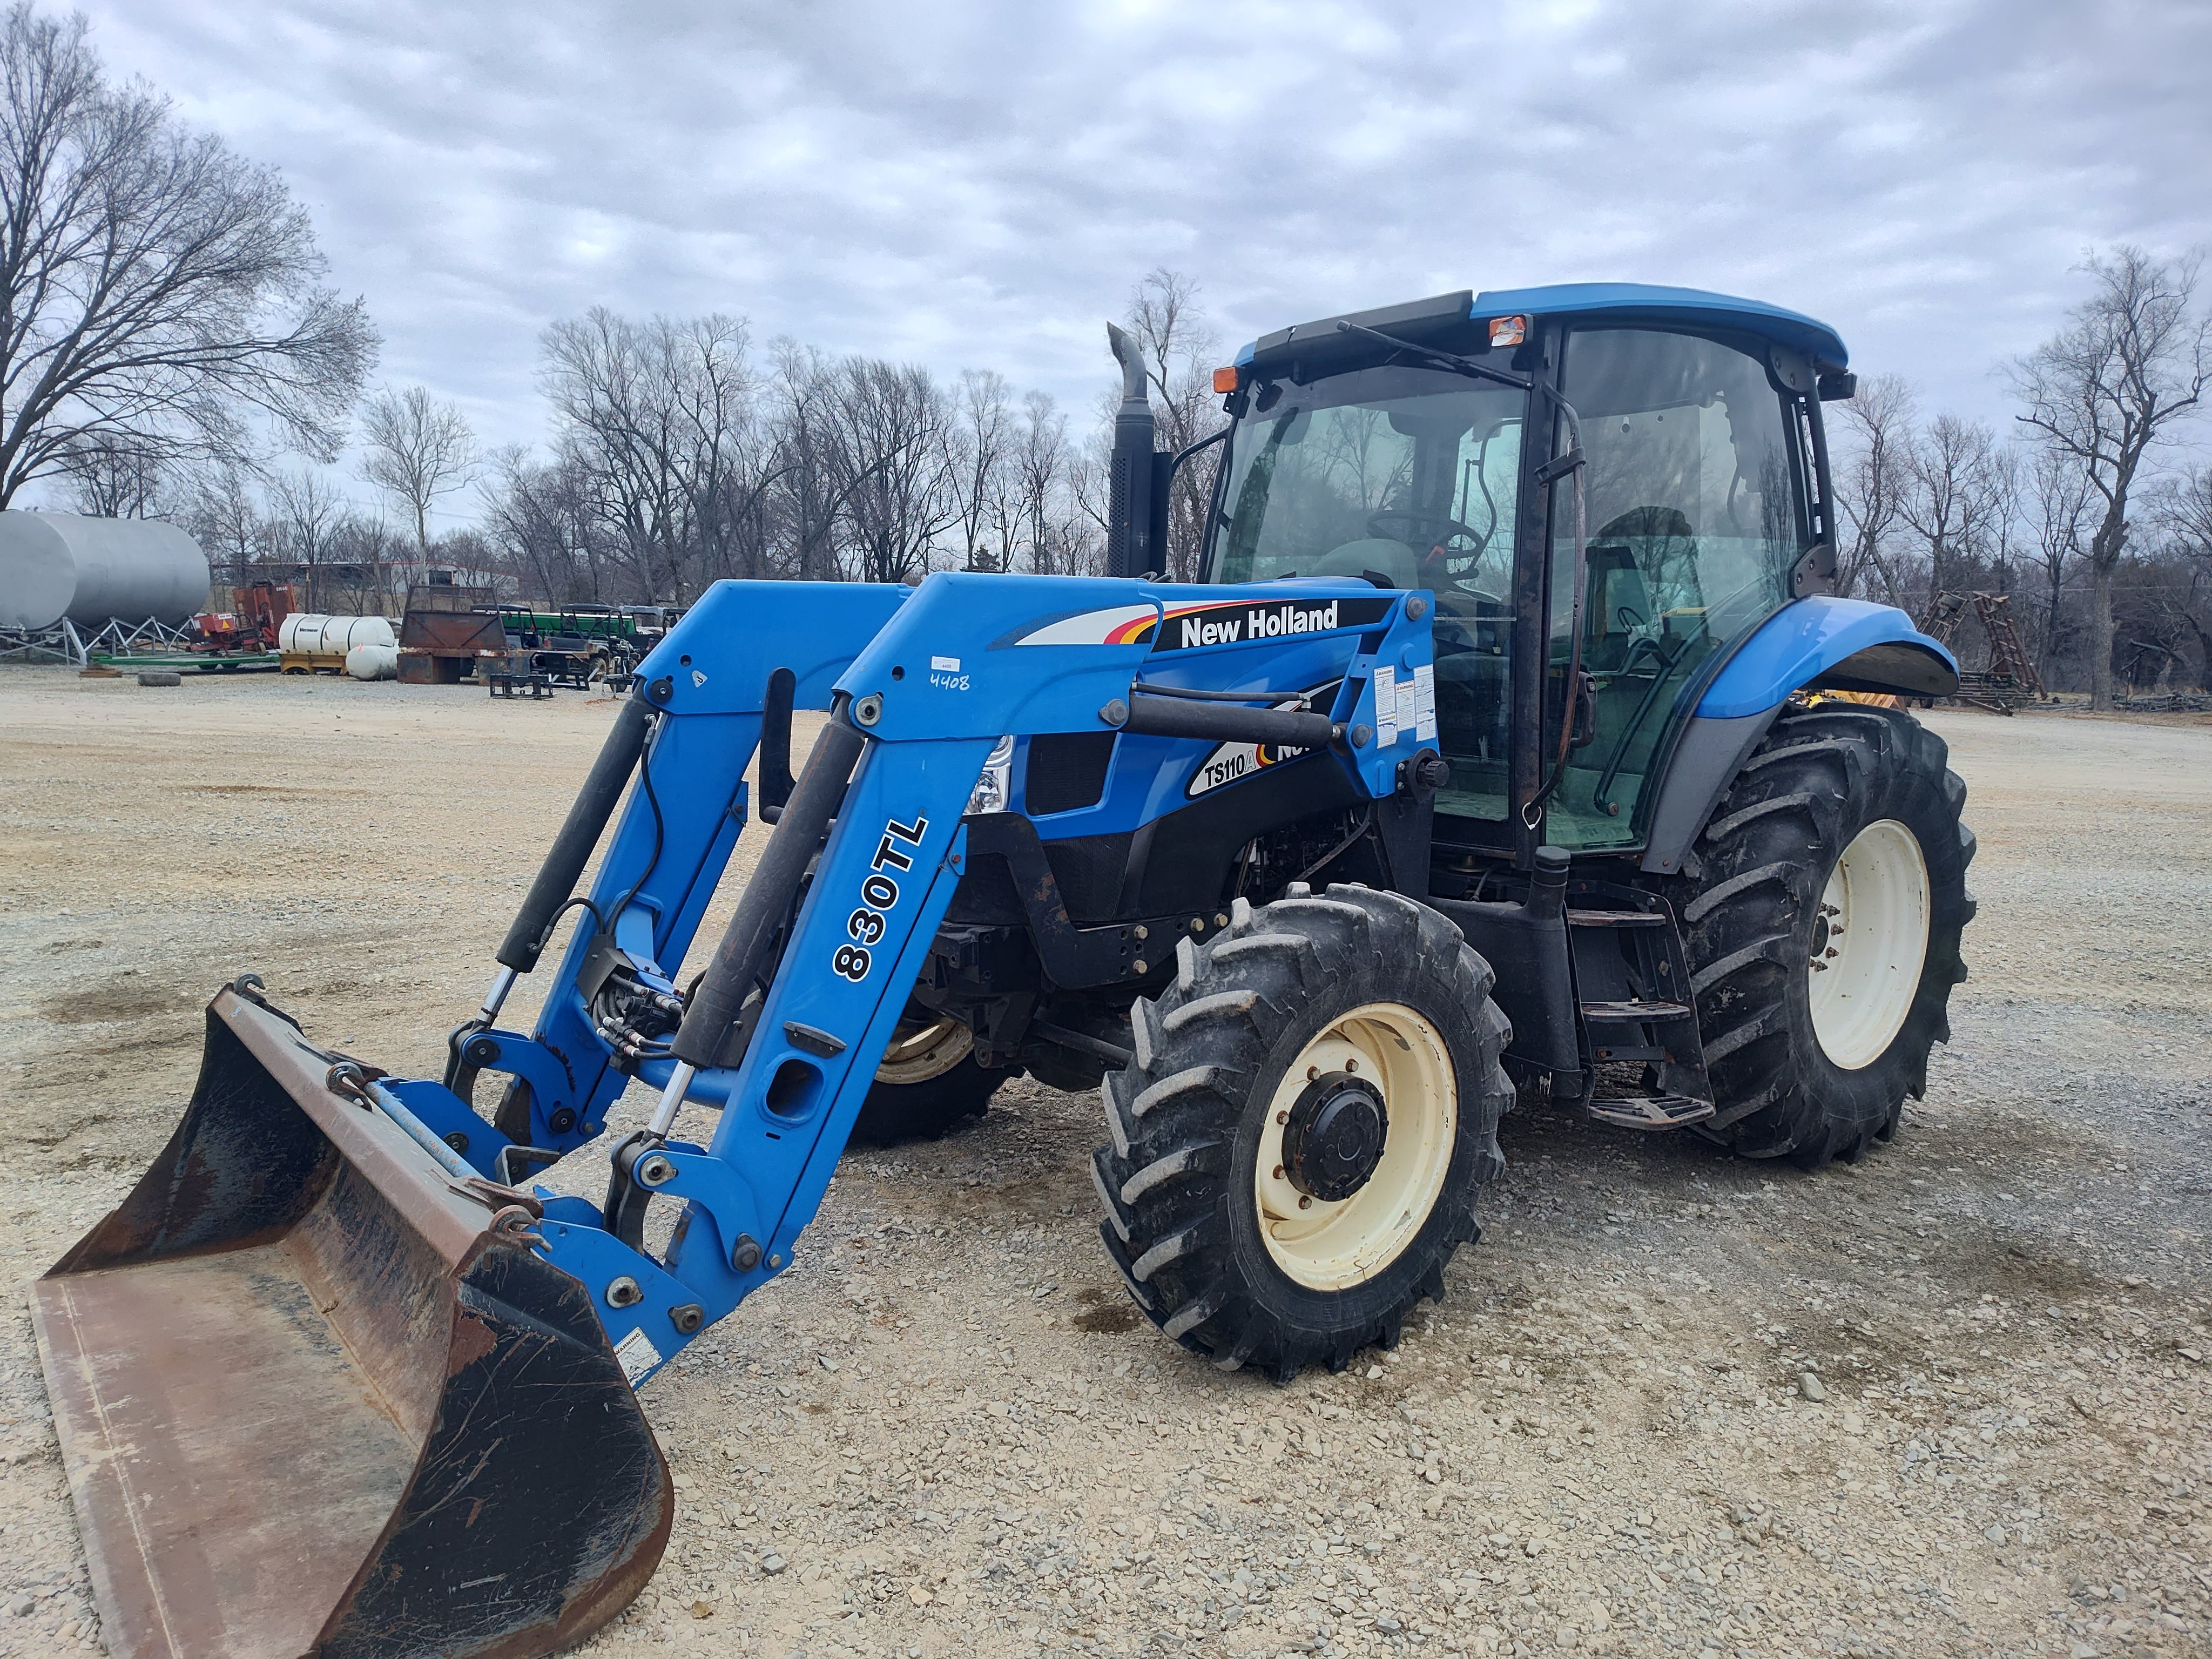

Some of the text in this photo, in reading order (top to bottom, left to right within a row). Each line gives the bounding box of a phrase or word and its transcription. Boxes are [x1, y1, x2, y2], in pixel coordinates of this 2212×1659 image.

[1182, 600, 1338, 648] New Holland
[930, 673, 970, 691] 4408
[1205, 750, 1256, 787] TS110A
[832, 817, 929, 982] 830TL
[615, 1332, 641, 1355] WARNING
